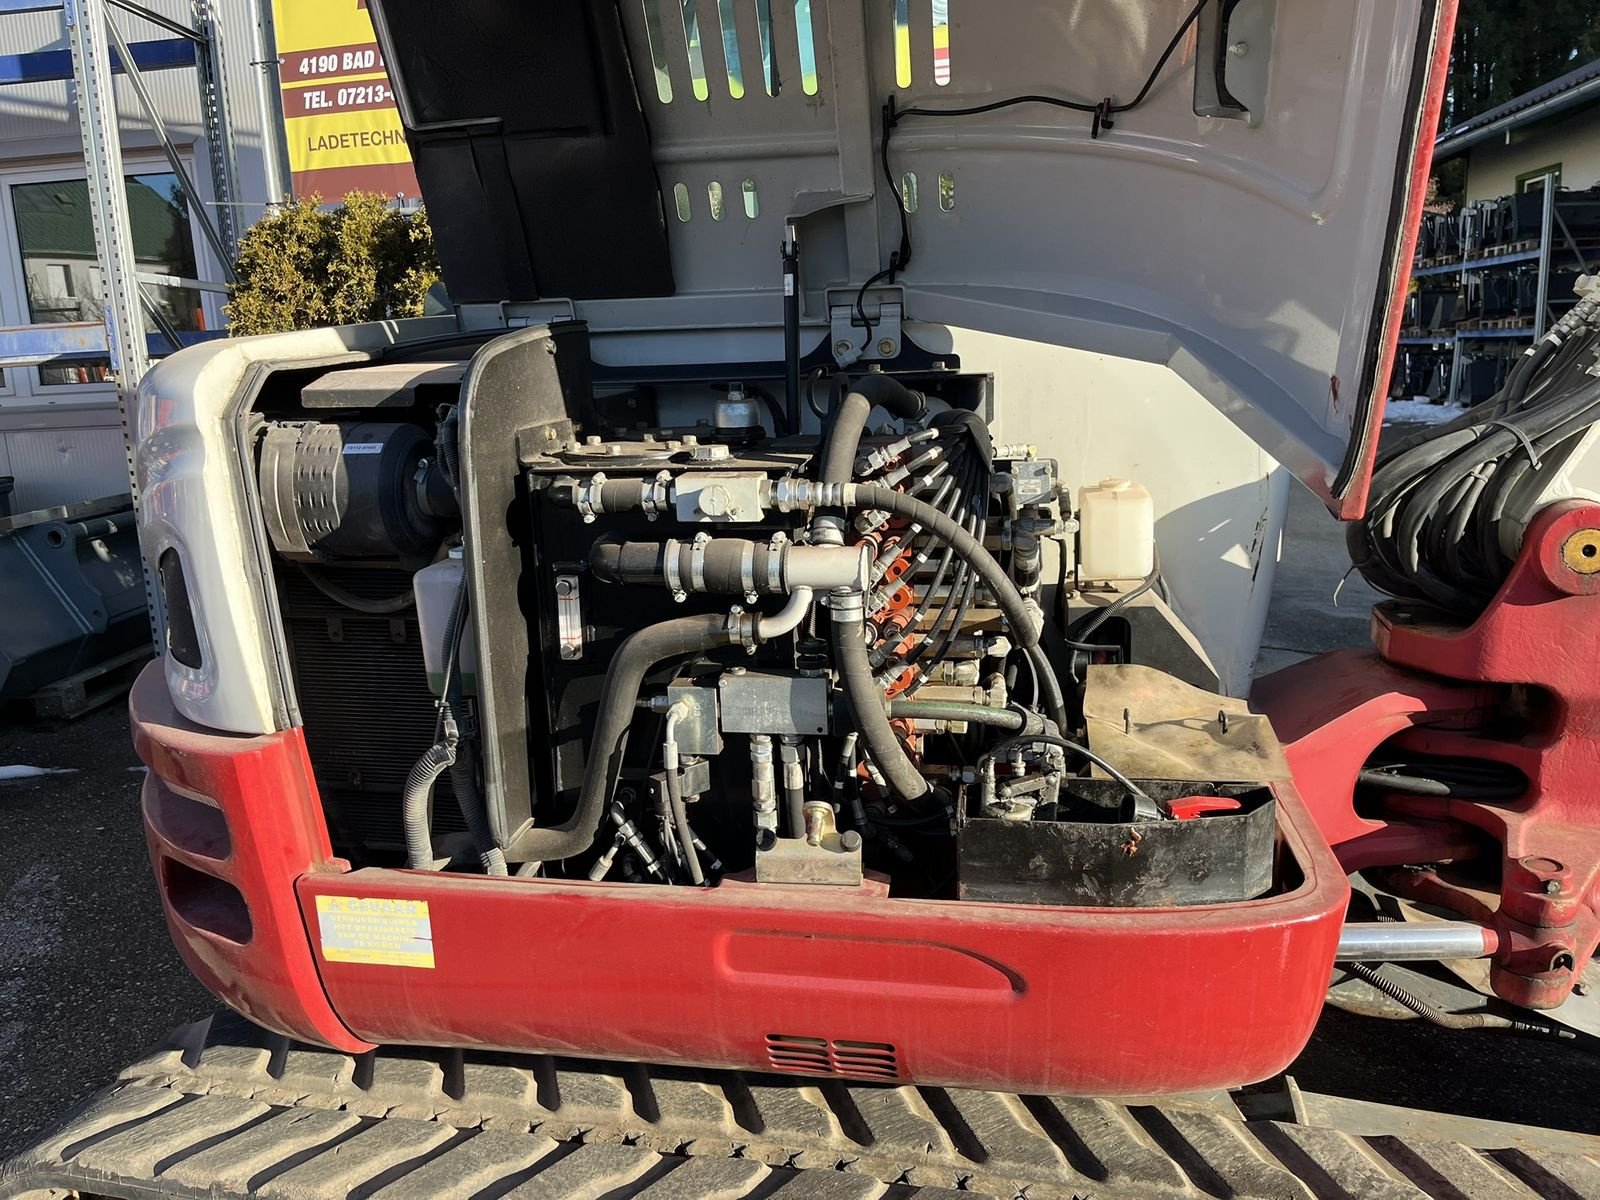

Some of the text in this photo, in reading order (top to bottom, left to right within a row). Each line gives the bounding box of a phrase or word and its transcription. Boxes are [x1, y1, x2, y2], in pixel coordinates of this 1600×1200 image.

[299, 54, 338, 75] 4190
[342, 50, 375, 71] BAD
[303, 90, 333, 110] TEL.
